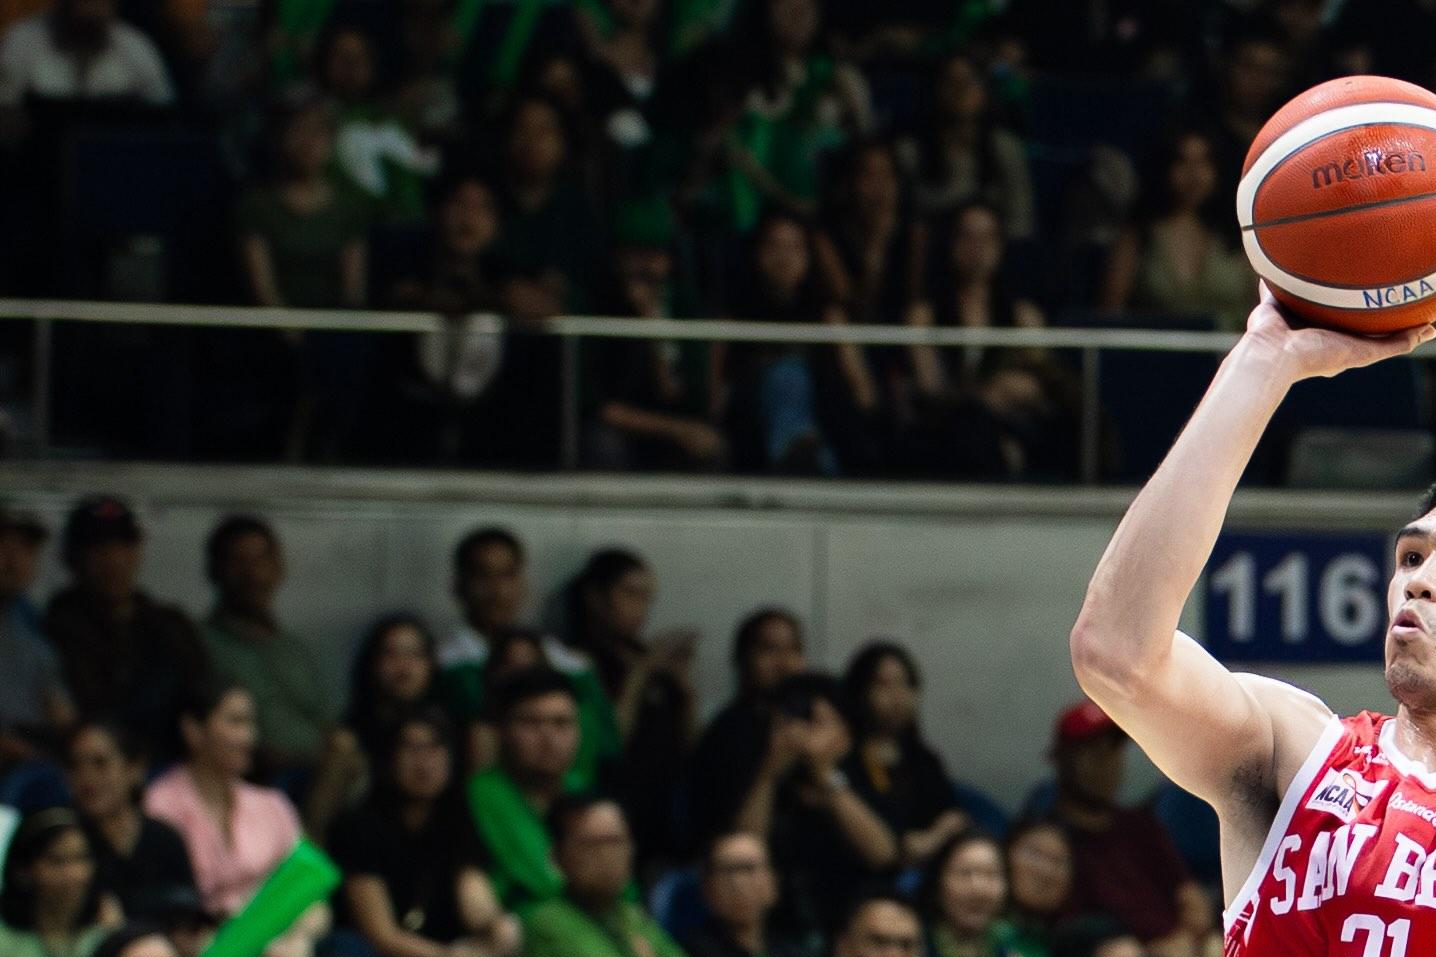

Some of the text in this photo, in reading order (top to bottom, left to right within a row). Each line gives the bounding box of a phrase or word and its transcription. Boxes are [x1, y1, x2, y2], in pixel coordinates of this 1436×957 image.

[1310, 150, 1426, 189] molten
[1362, 279, 1434, 309] NCAA
[1210, 551, 1379, 645] 116
[1270, 824, 1378, 916] SAN
